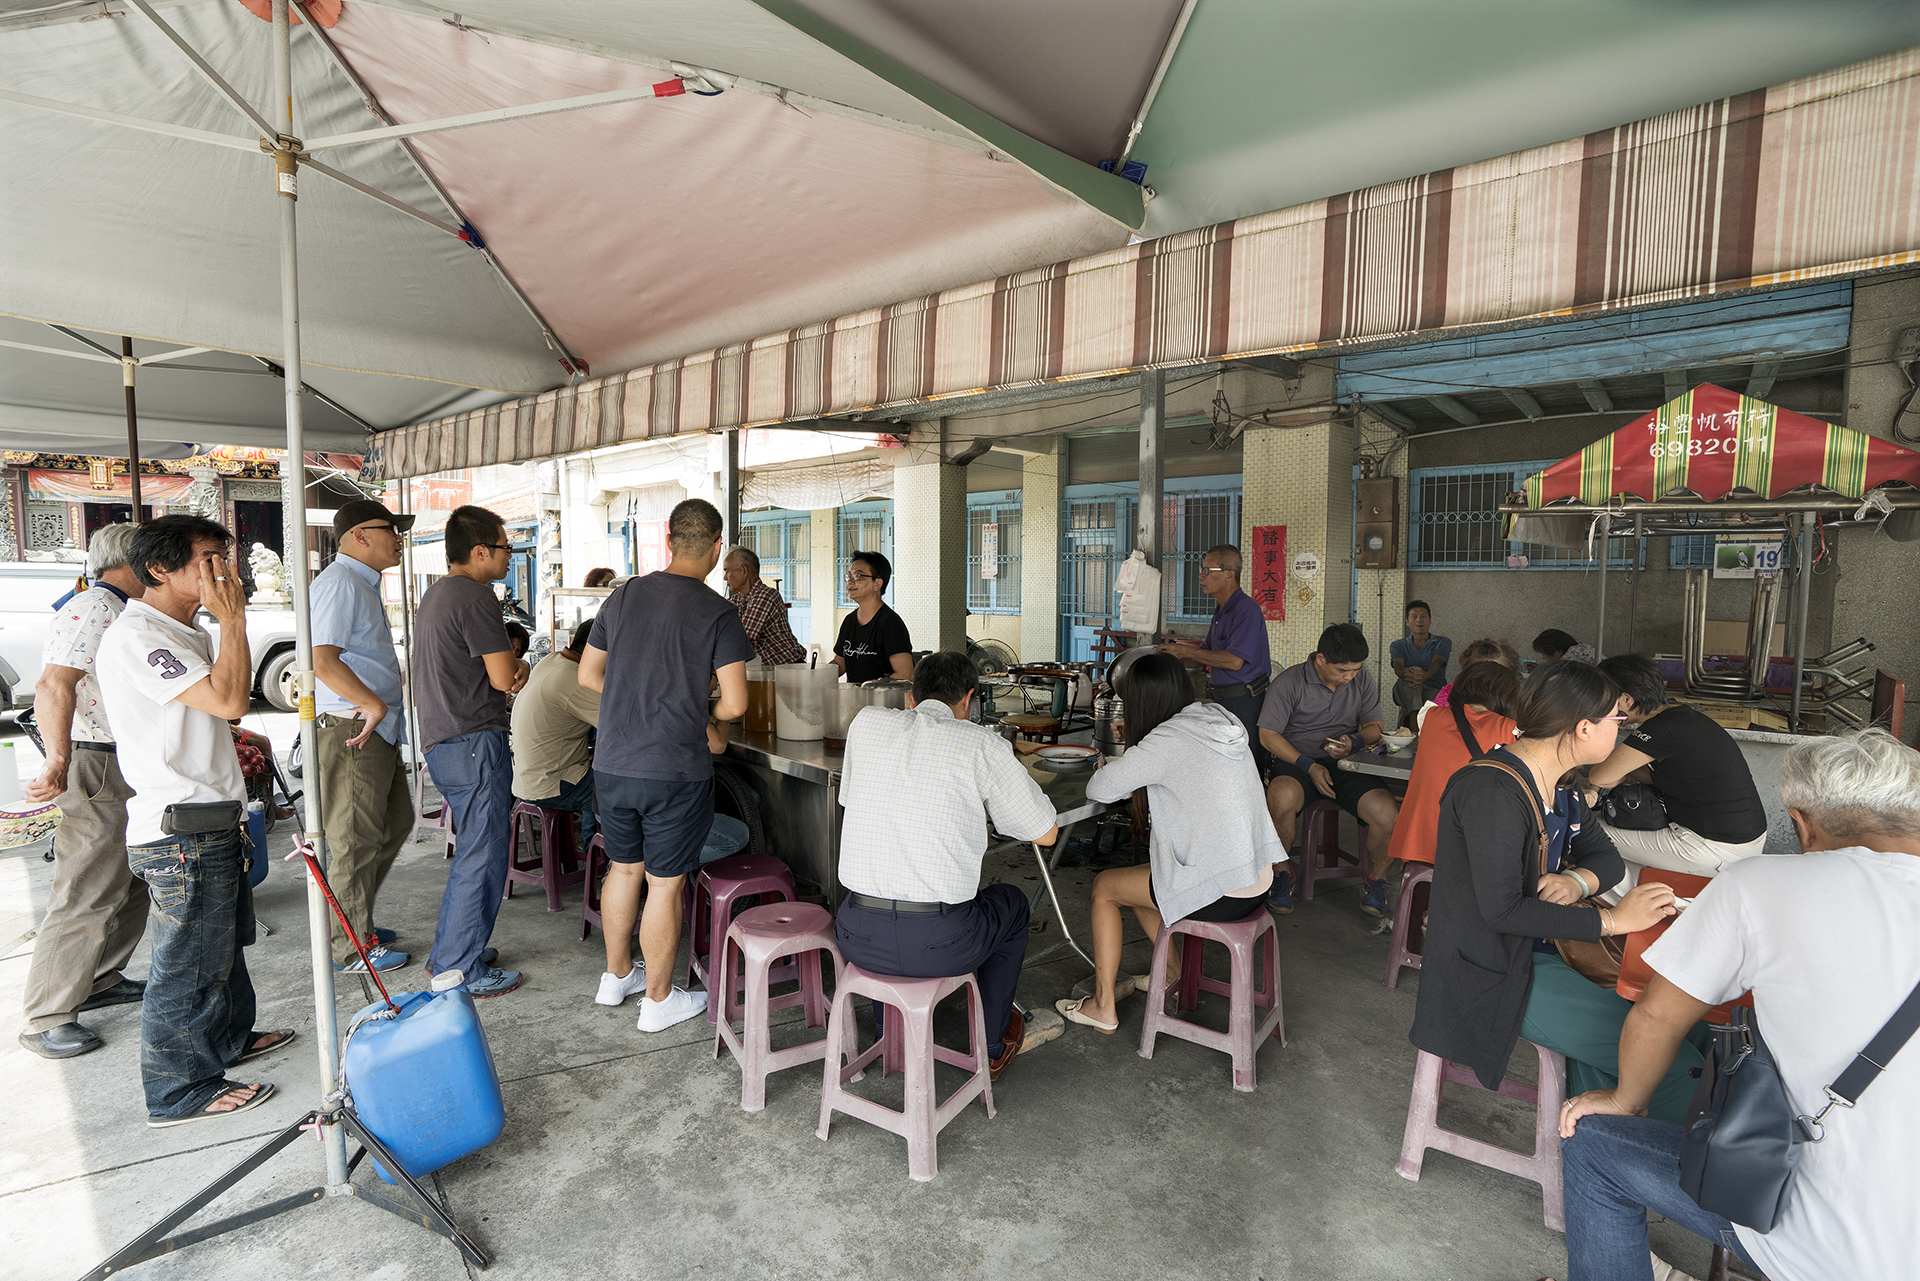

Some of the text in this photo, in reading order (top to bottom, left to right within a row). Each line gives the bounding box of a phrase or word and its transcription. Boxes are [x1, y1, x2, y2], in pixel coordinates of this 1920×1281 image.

[1647, 407, 1773, 436] 裕豐帆布行
[1649, 435, 1768, 458] 6982011
[1261, 529, 1279, 602] 諸事大吉
[1756, 550, 1778, 568] 19
[147, 648, 188, 679] 3
